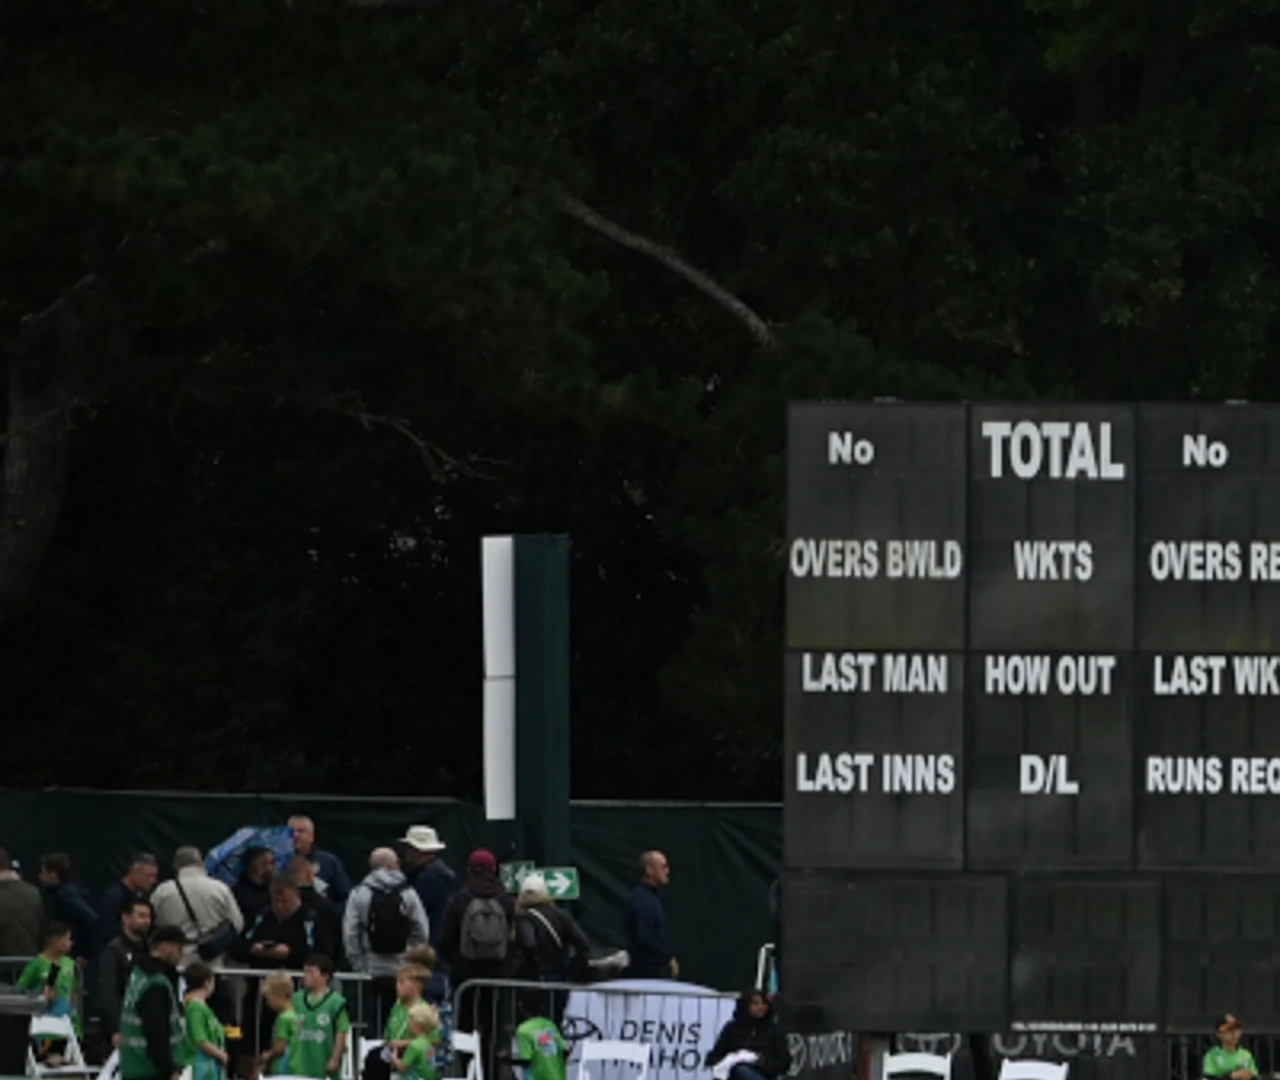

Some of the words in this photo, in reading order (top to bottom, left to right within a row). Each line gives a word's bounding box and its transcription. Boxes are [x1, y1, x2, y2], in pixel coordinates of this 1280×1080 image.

[829, 432, 874, 464] No
[982, 422, 1125, 479] TOTAL
[1183, 435, 1228, 468] No
[791, 539, 879, 578] OVERS
[886, 540, 962, 579] BWLD
[1014, 542, 1094, 580] WKTS
[1150, 542, 1242, 580] OVERS
[803, 654, 875, 692] LAST
[883, 656, 948, 692] MAN
[985, 656, 1050, 694] HOW
[1056, 656, 1116, 694] OUT
[1154, 656, 1226, 695] LAST
[797, 754, 874, 792] LAST
[882, 755, 955, 792] INNS
[1020, 756, 1079, 793] D/L
[1146, 757, 1223, 793] RUNS
[620, 1019, 703, 1046] DENIS
